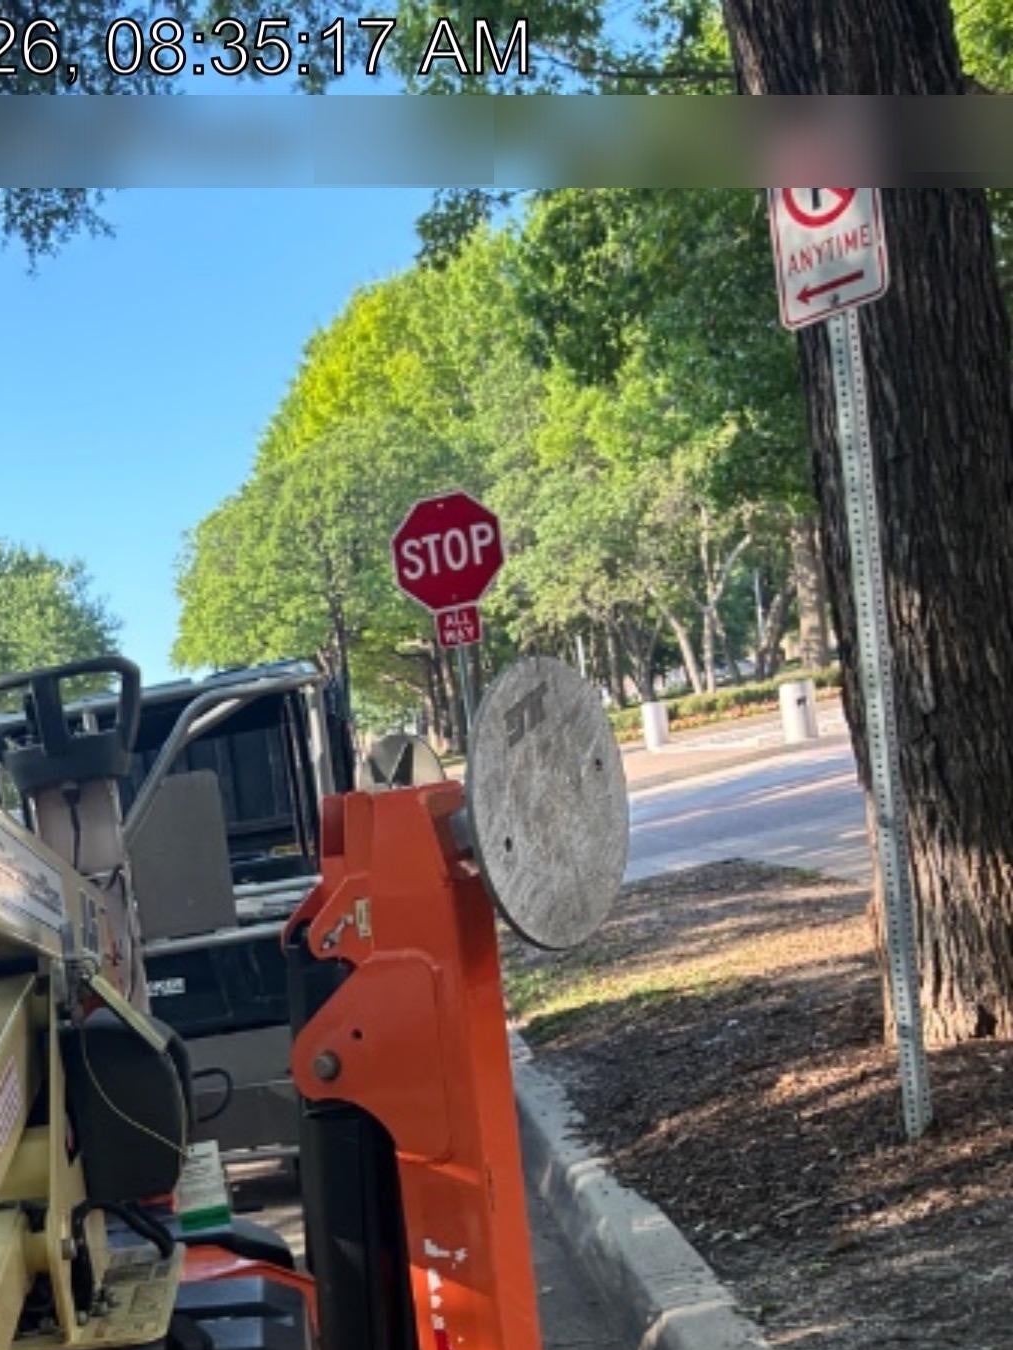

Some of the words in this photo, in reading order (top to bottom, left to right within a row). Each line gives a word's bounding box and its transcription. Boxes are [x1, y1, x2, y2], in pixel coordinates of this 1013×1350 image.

[788, 224, 872, 276] ANYTIME
[400, 521, 495, 581] STOP
[444, 625, 475, 644] WAY
[445, 610, 470, 627] ALL
